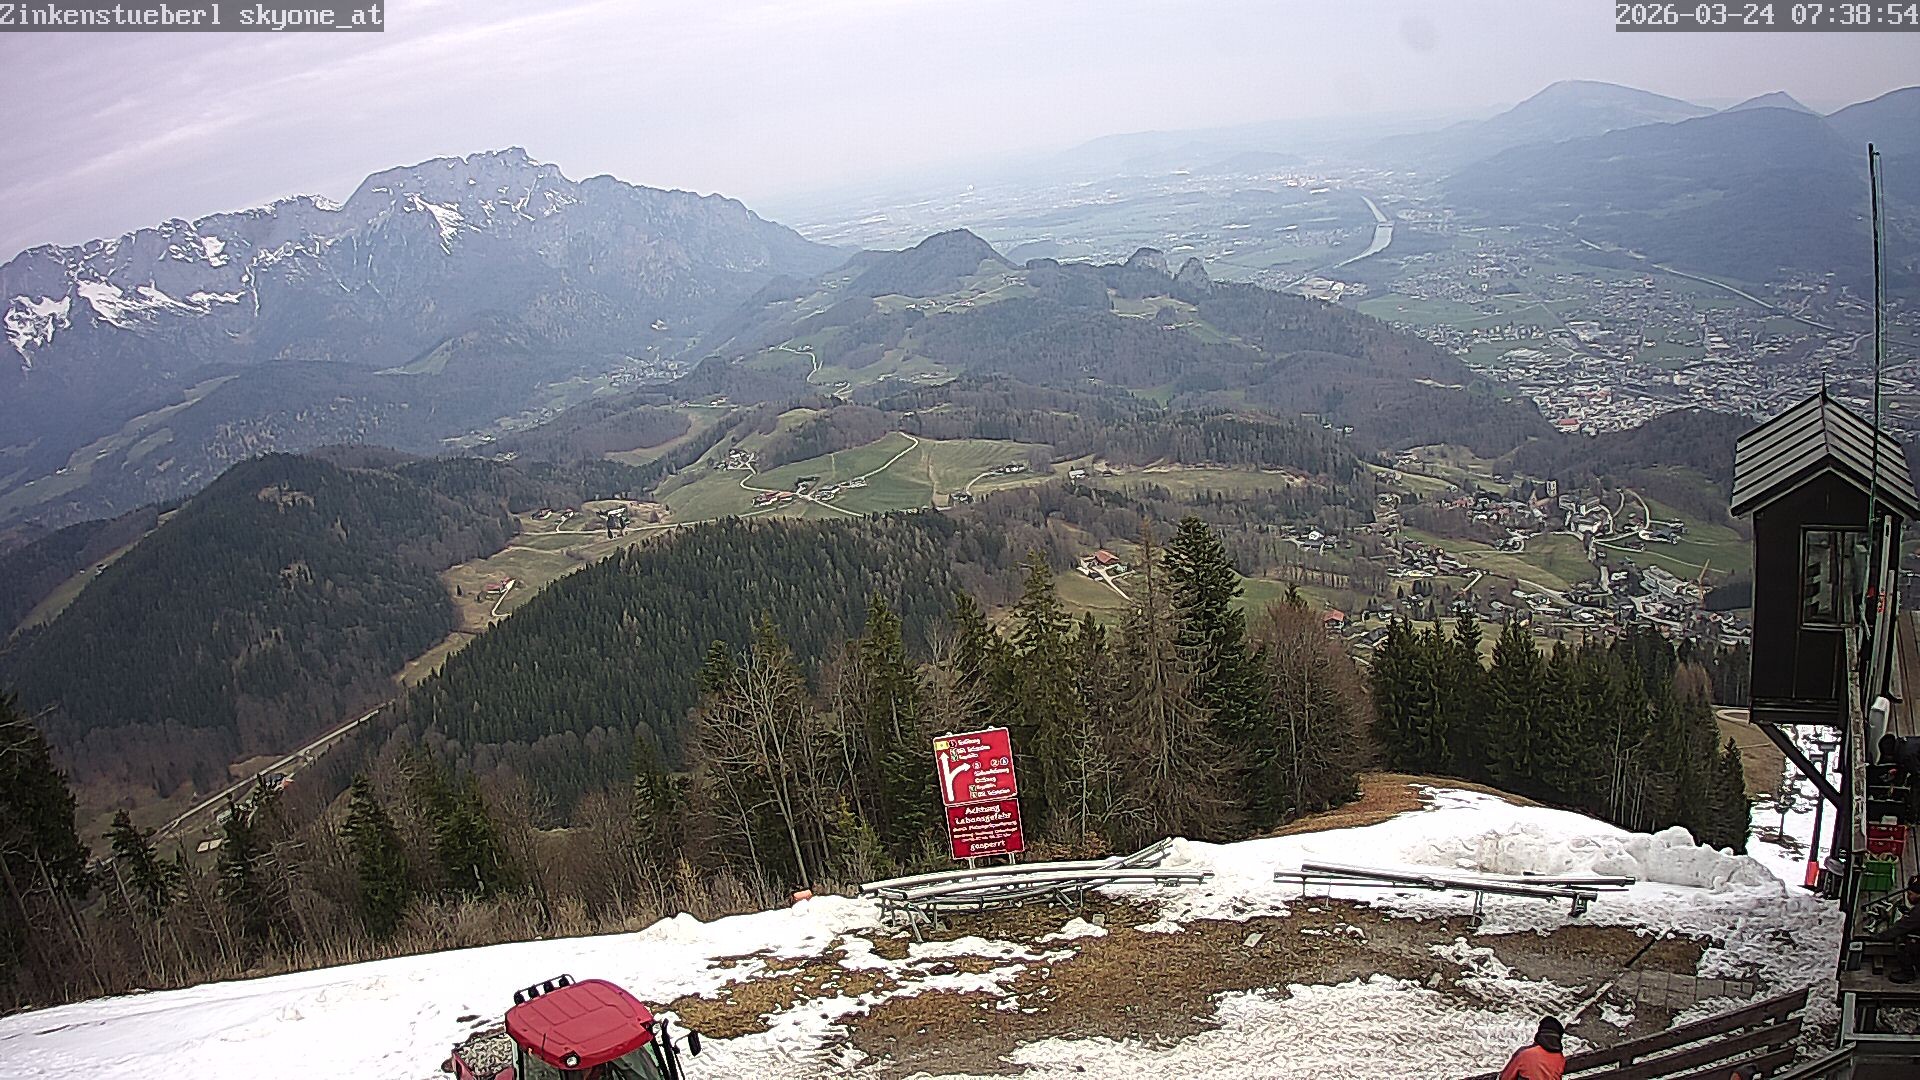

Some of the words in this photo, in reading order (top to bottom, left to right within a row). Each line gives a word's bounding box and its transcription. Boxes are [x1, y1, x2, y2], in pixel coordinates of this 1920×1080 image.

[965, 805, 1000, 815] Achtung
[955, 812, 1011, 824] Lebensgefahr
[970, 840, 1006, 851] gesperrt
